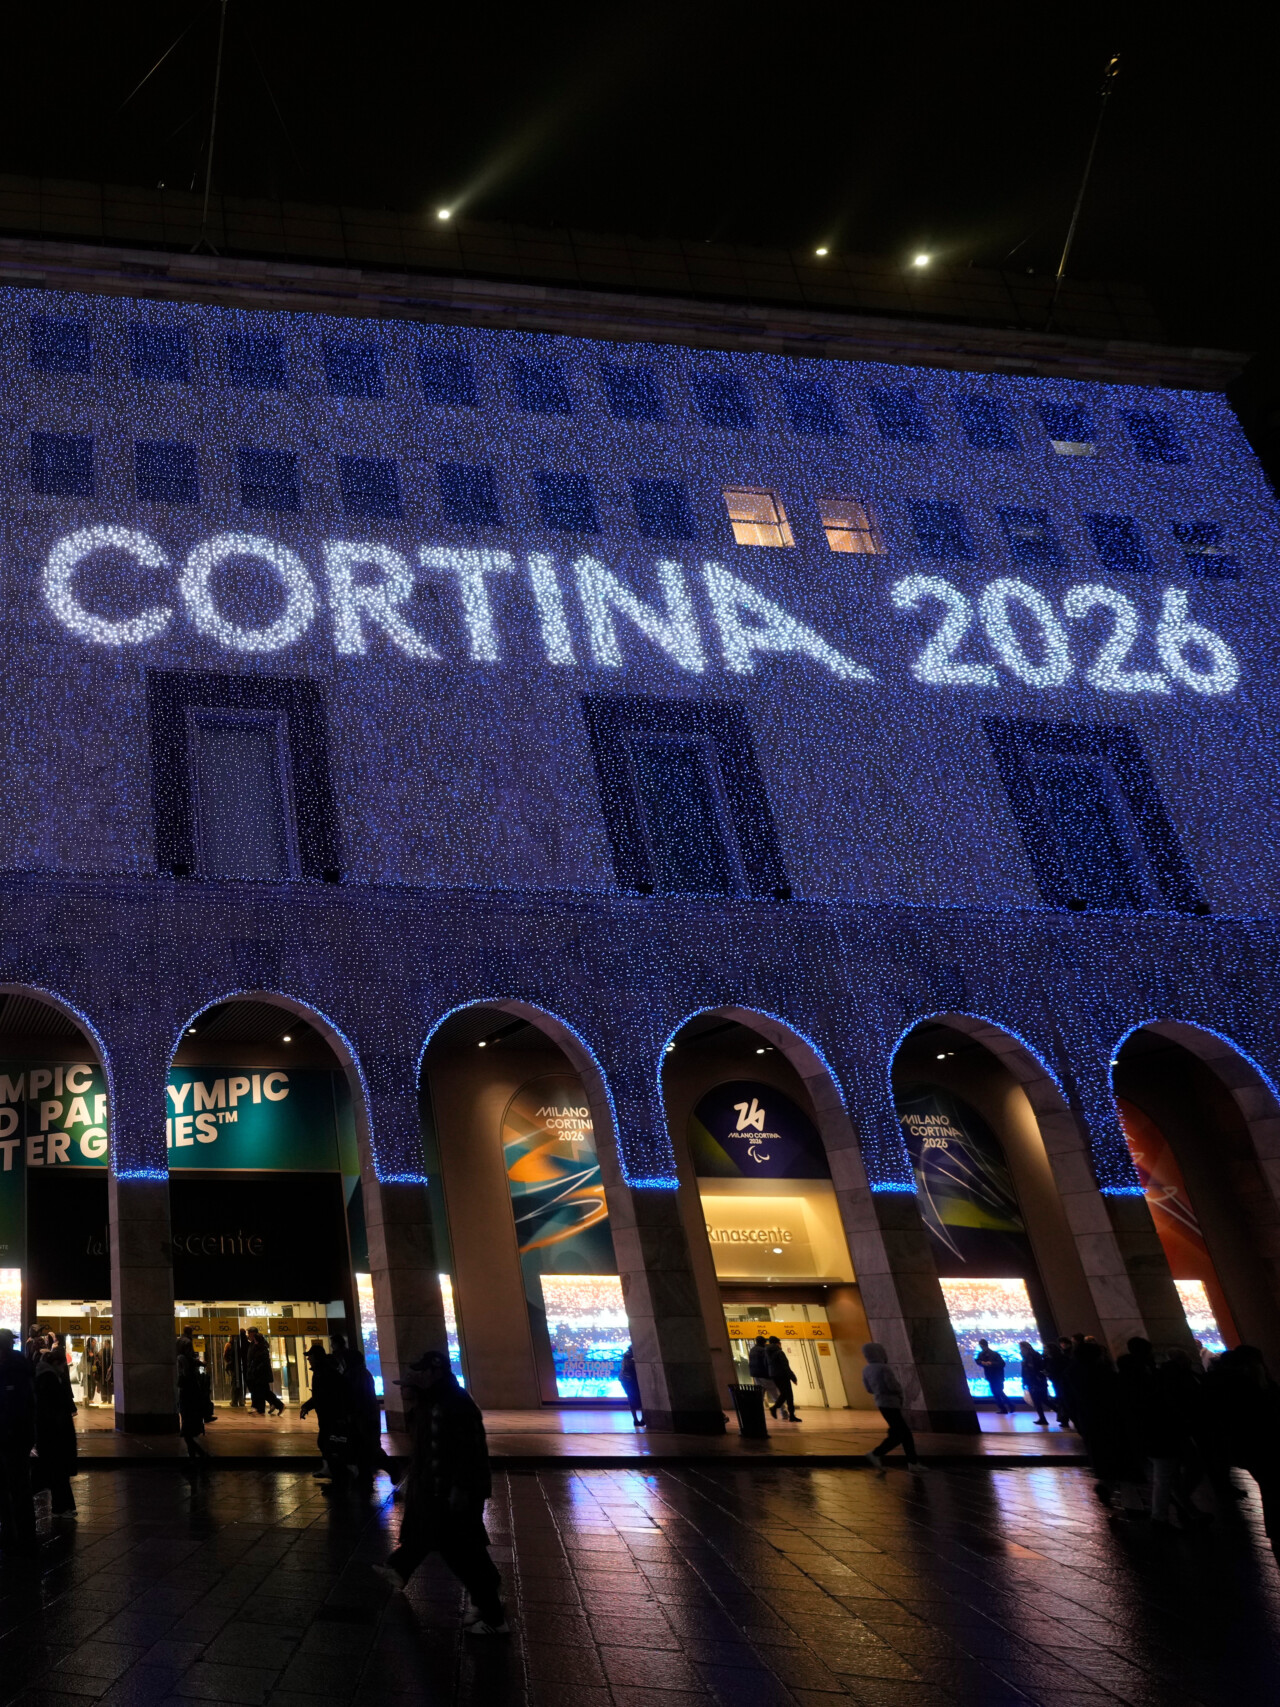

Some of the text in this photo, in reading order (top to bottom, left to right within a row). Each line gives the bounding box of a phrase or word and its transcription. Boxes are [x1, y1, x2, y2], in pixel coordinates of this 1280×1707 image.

[40, 523, 875, 683] CORTINA
[890, 574, 1240, 695] 2026
[535, 1106, 589, 1118] MILANO
[900, 1114, 950, 1126] MILANO
[557, 1130, 585, 1141] 2026
[910, 1126, 964, 1137] CORTINA
[922, 1137, 949, 1148] 2026
[705, 1223, 793, 1243] Rinascente
[564, 1361, 615, 1370] EMOTIONS
[561, 1370, 611, 1378] TOGETHER
